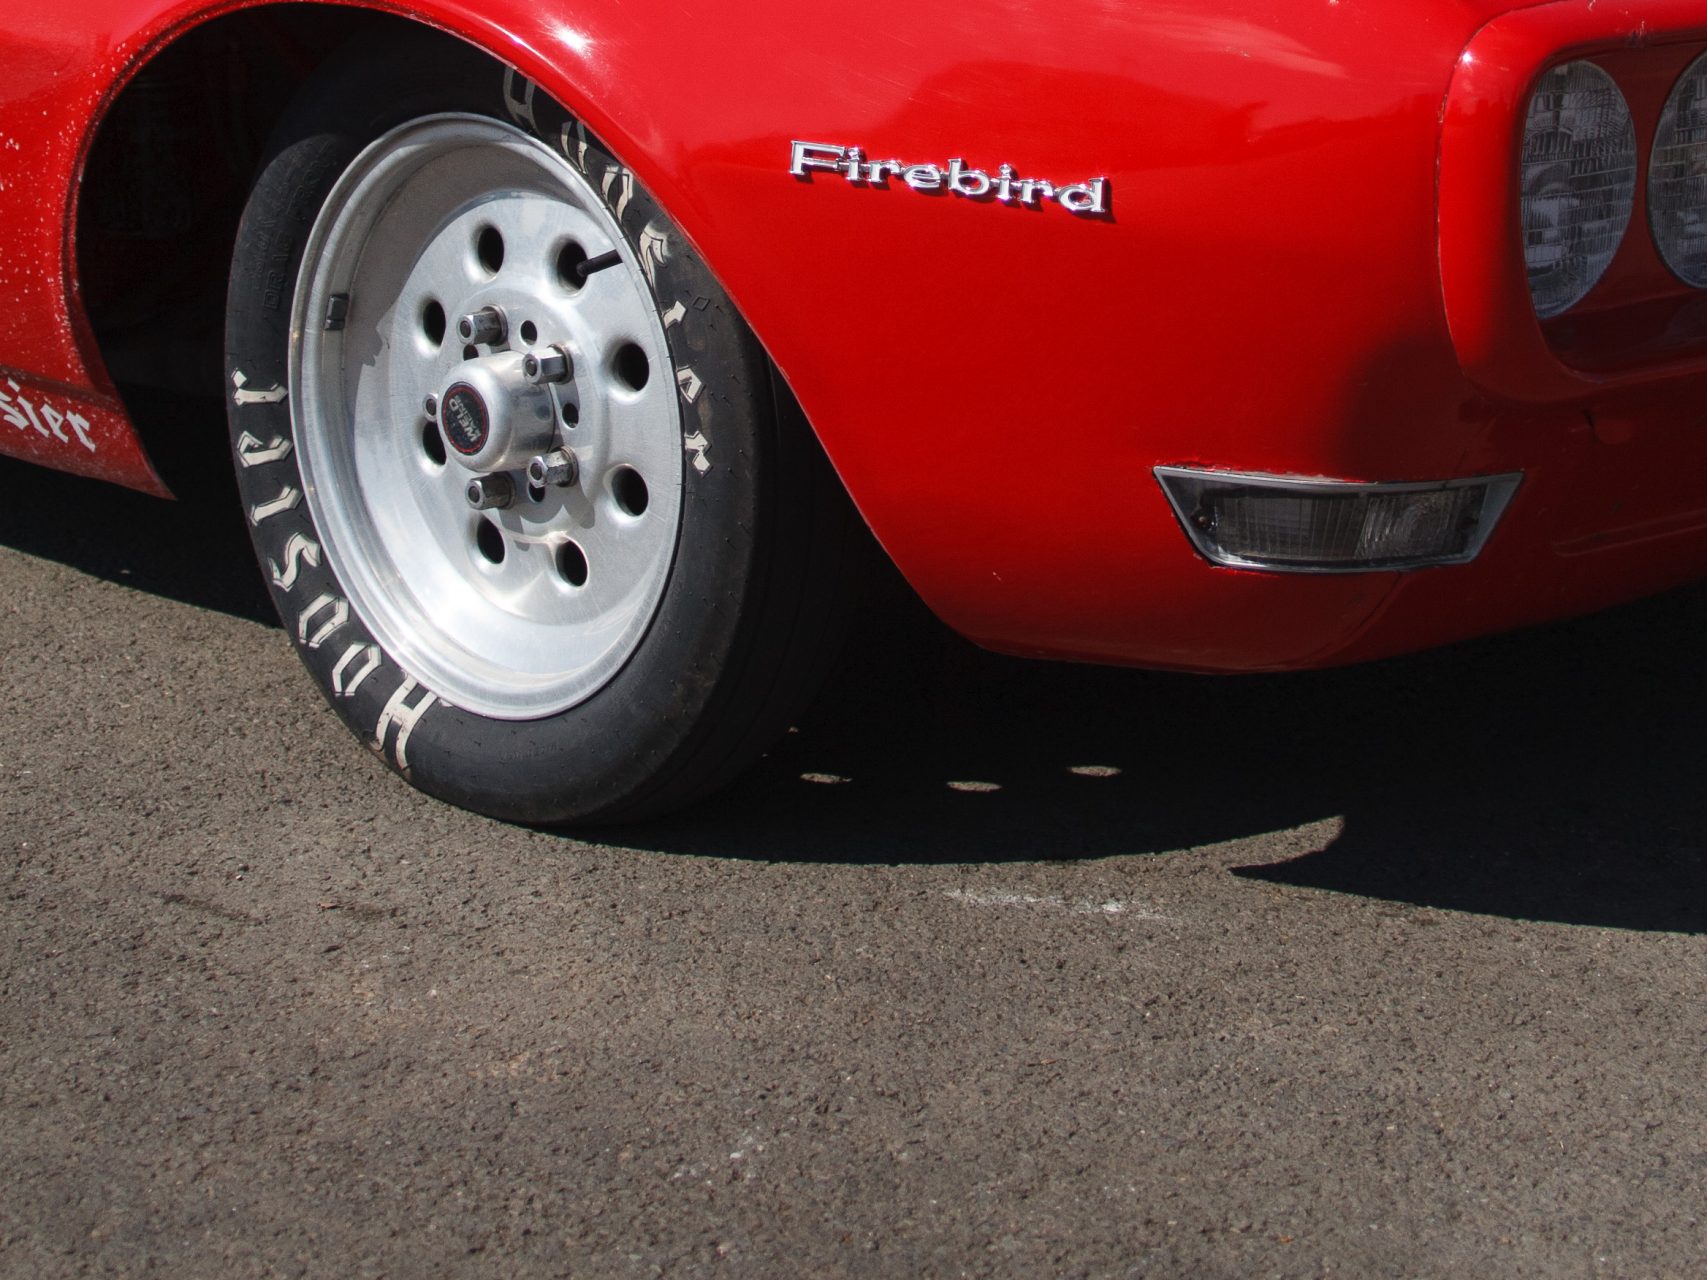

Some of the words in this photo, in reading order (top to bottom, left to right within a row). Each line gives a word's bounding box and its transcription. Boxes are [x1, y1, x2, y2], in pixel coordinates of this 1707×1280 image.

[789, 139, 1108, 212] Firebird
[448, 398, 478, 442] WELD
[230, 367, 440, 782] Hoosier
